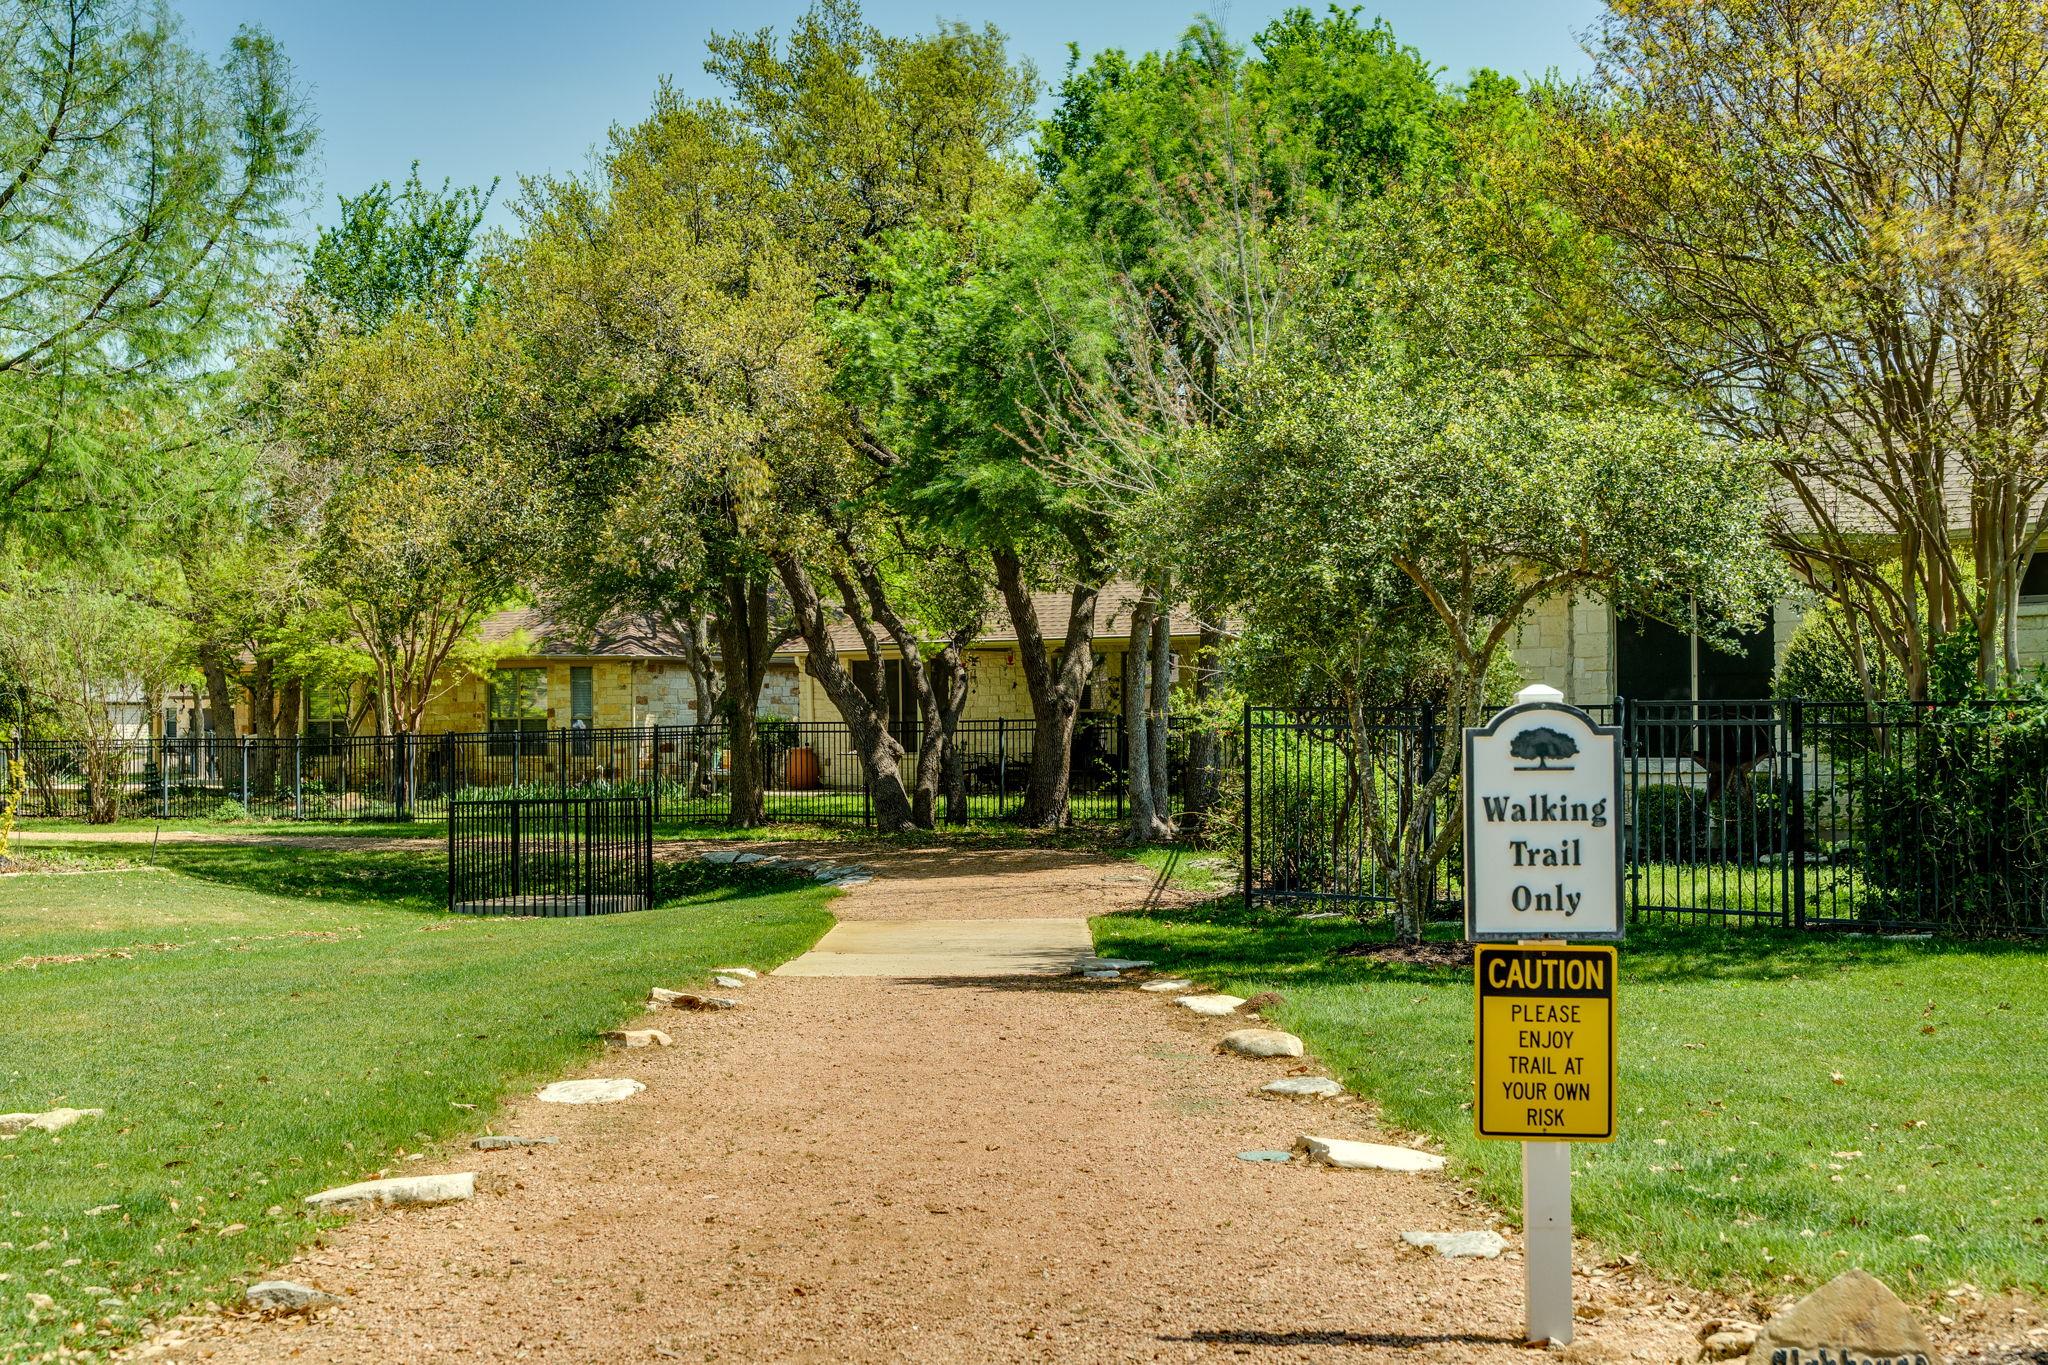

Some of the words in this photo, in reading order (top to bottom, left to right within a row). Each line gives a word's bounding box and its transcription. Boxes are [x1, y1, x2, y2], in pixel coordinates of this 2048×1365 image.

[1482, 793, 1607, 828] Walking
[1509, 838, 1582, 867] Trail
[1511, 883, 1582, 917] Only
[1488, 958, 1604, 990] CAUTION
[1511, 1004, 1582, 1024] PLEASE
[1519, 1030, 1574, 1049] ENJOY
[1508, 1055, 1558, 1075] TRAIL
[1563, 1056, 1585, 1076] AT
[1502, 1081, 1547, 1101] YOUR
[1553, 1082, 1590, 1102] OWN
[1526, 1107, 1565, 1127] RISK
